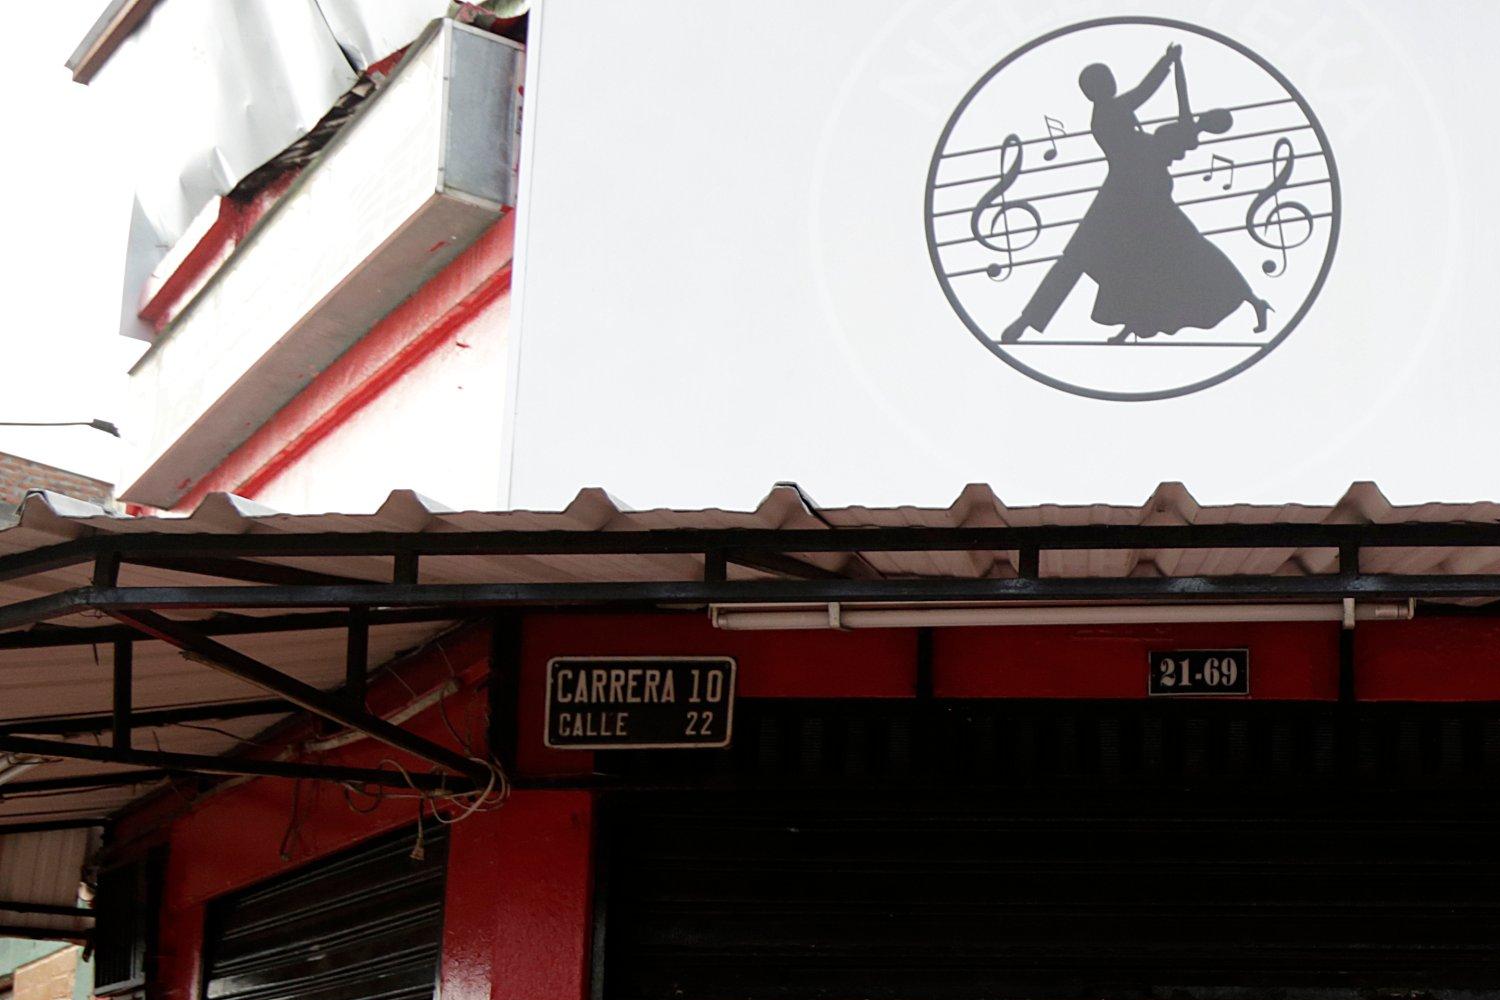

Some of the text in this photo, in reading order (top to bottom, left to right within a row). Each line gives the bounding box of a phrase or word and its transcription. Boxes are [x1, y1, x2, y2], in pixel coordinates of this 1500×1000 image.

[556, 668, 724, 704] CARRERA 10
[1159, 657, 1238, 687] 21-69
[558, 710, 714, 737] CALLE 22
